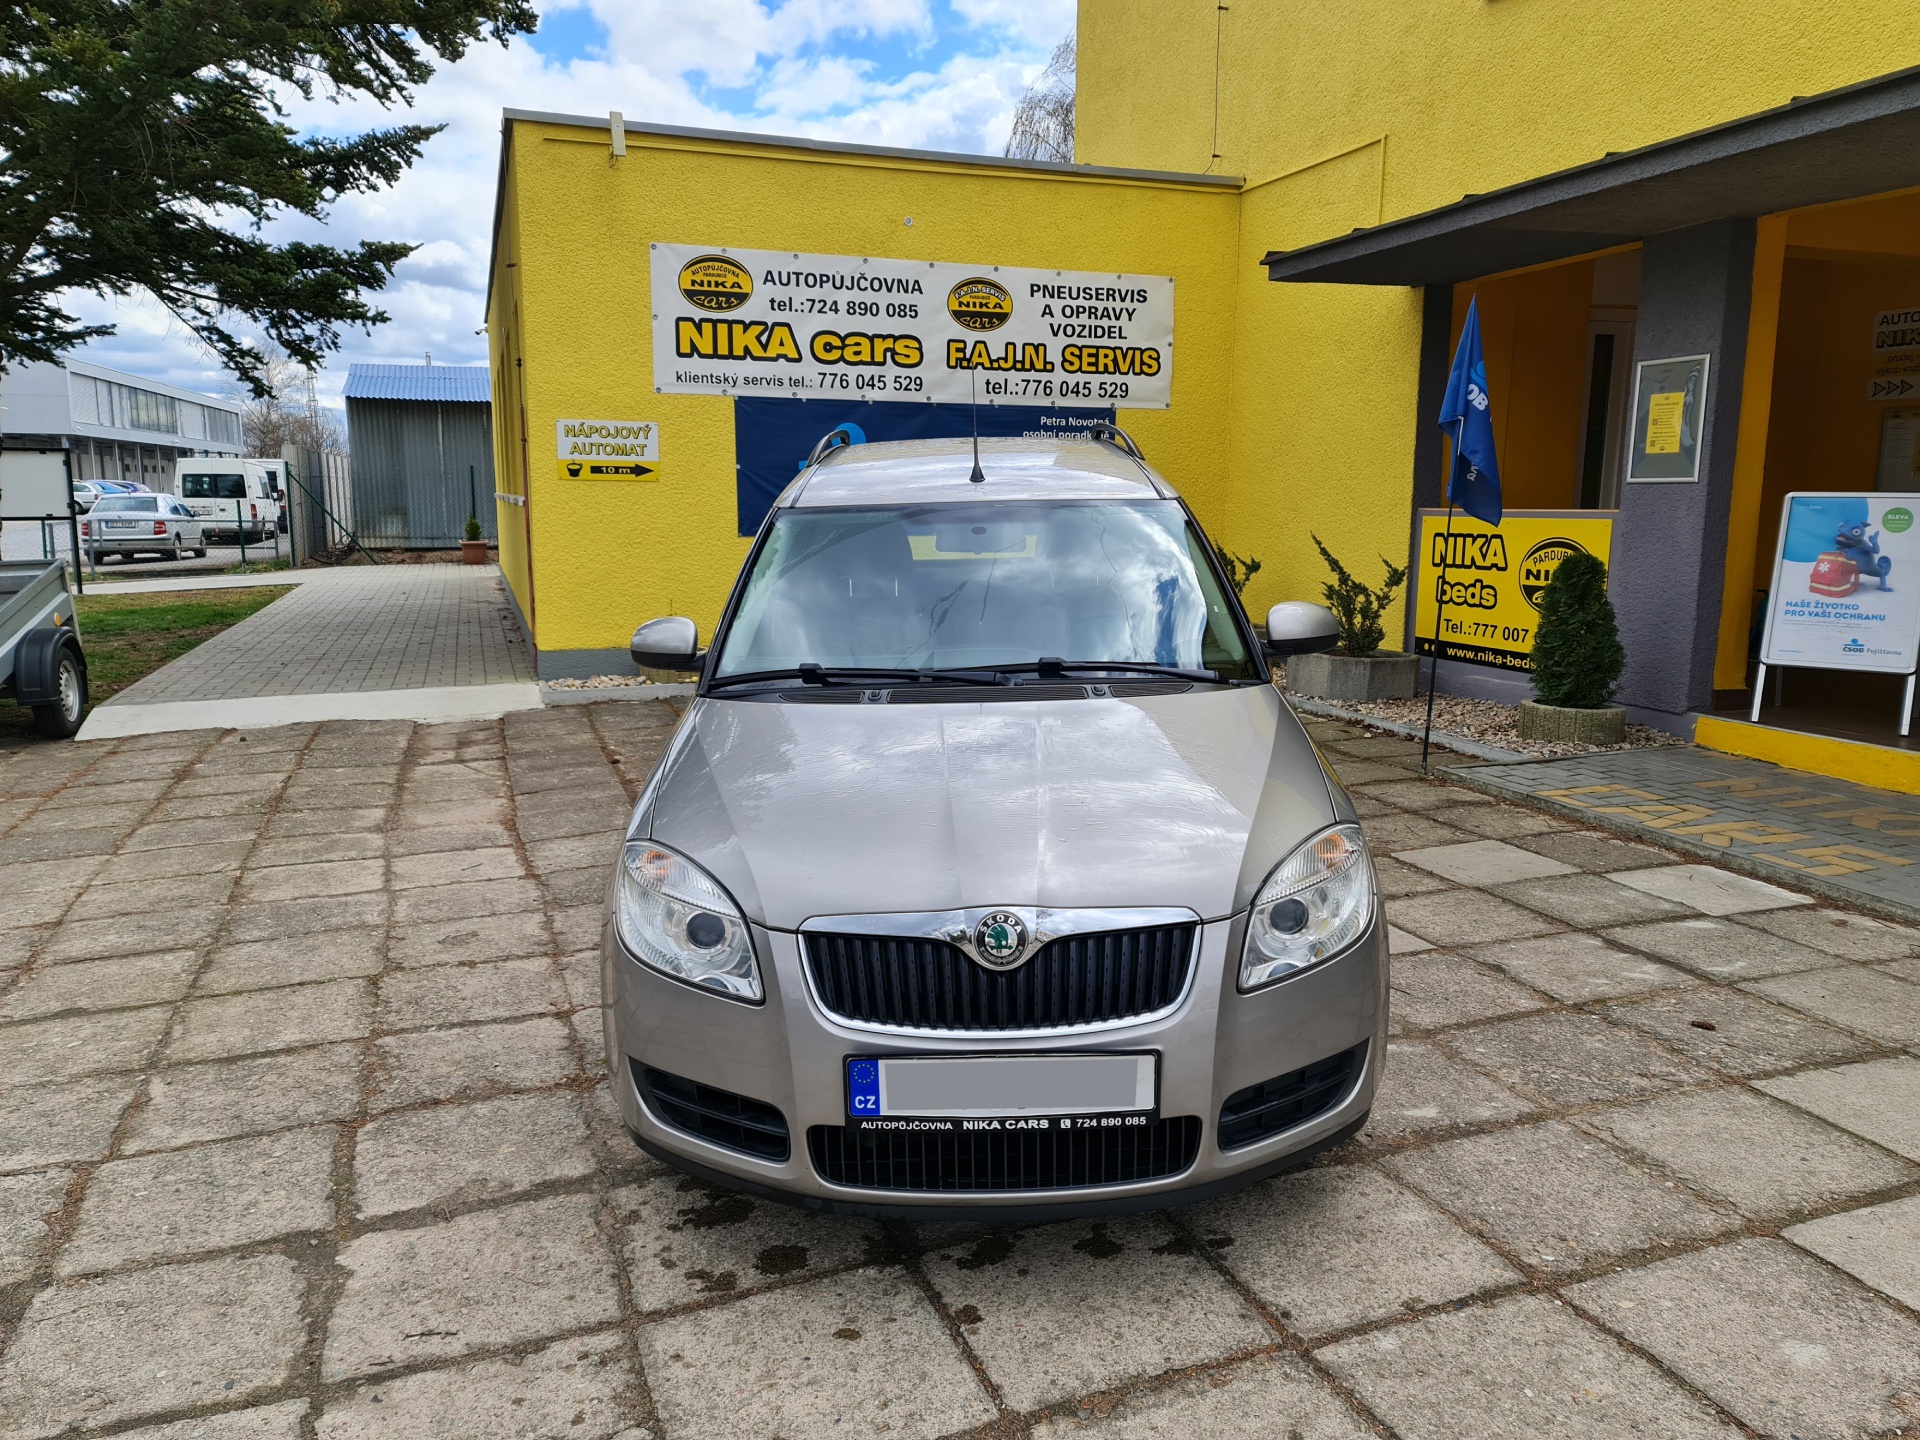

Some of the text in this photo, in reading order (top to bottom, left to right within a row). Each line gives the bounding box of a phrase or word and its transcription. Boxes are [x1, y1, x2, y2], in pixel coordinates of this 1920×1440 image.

[691, 263, 740, 279] AUTOPŮJČOVNA
[690, 279, 744, 290] NIKA
[762, 270, 924, 296] AUTOPŮJČOVNA
[981, 286, 1007, 302] SERVIS
[1029, 283, 1149, 304] PNEUSERVIS
[693, 296, 740, 308] cars
[769, 297, 919, 319] tel.:724 890 085
[958, 301, 1005, 310] NIKA
[1040, 304, 1137, 322] A OPRAVY
[960, 316, 1001, 328] cars
[1049, 323, 1128, 340] VOZIDEL
[675, 316, 924, 369] NIKA cars
[947, 339, 1162, 377] F.A.J.N. SERVIS
[1887, 353, 1914, 364] prodej
[675, 371, 924, 392] klientský servis tel.: 776 045 529
[985, 378, 1129, 399] tel.:776 045 529
[1040, 416, 1066, 426] Petra
[564, 422, 652, 440] NÁPOJOVÝ
[1023, 429, 1057, 439] osobní
[569, 442, 648, 457] AUTOMAT
[601, 466, 631, 474] 10 m
[1432, 533, 1508, 571] NIKA
[1436, 575, 1498, 610] beds
[1785, 600, 1860, 611] NAŠE ŽIVOTKO
[1784, 609, 1886, 621] PRO VAŠI OCHRANU
[1443, 618, 1530, 644] Tel.:777 007
[855, 1095, 876, 1109] CZ
[860, 1116, 1147, 1130] AUTOPŮJČOVNA NIKA CARS 724 890 085
